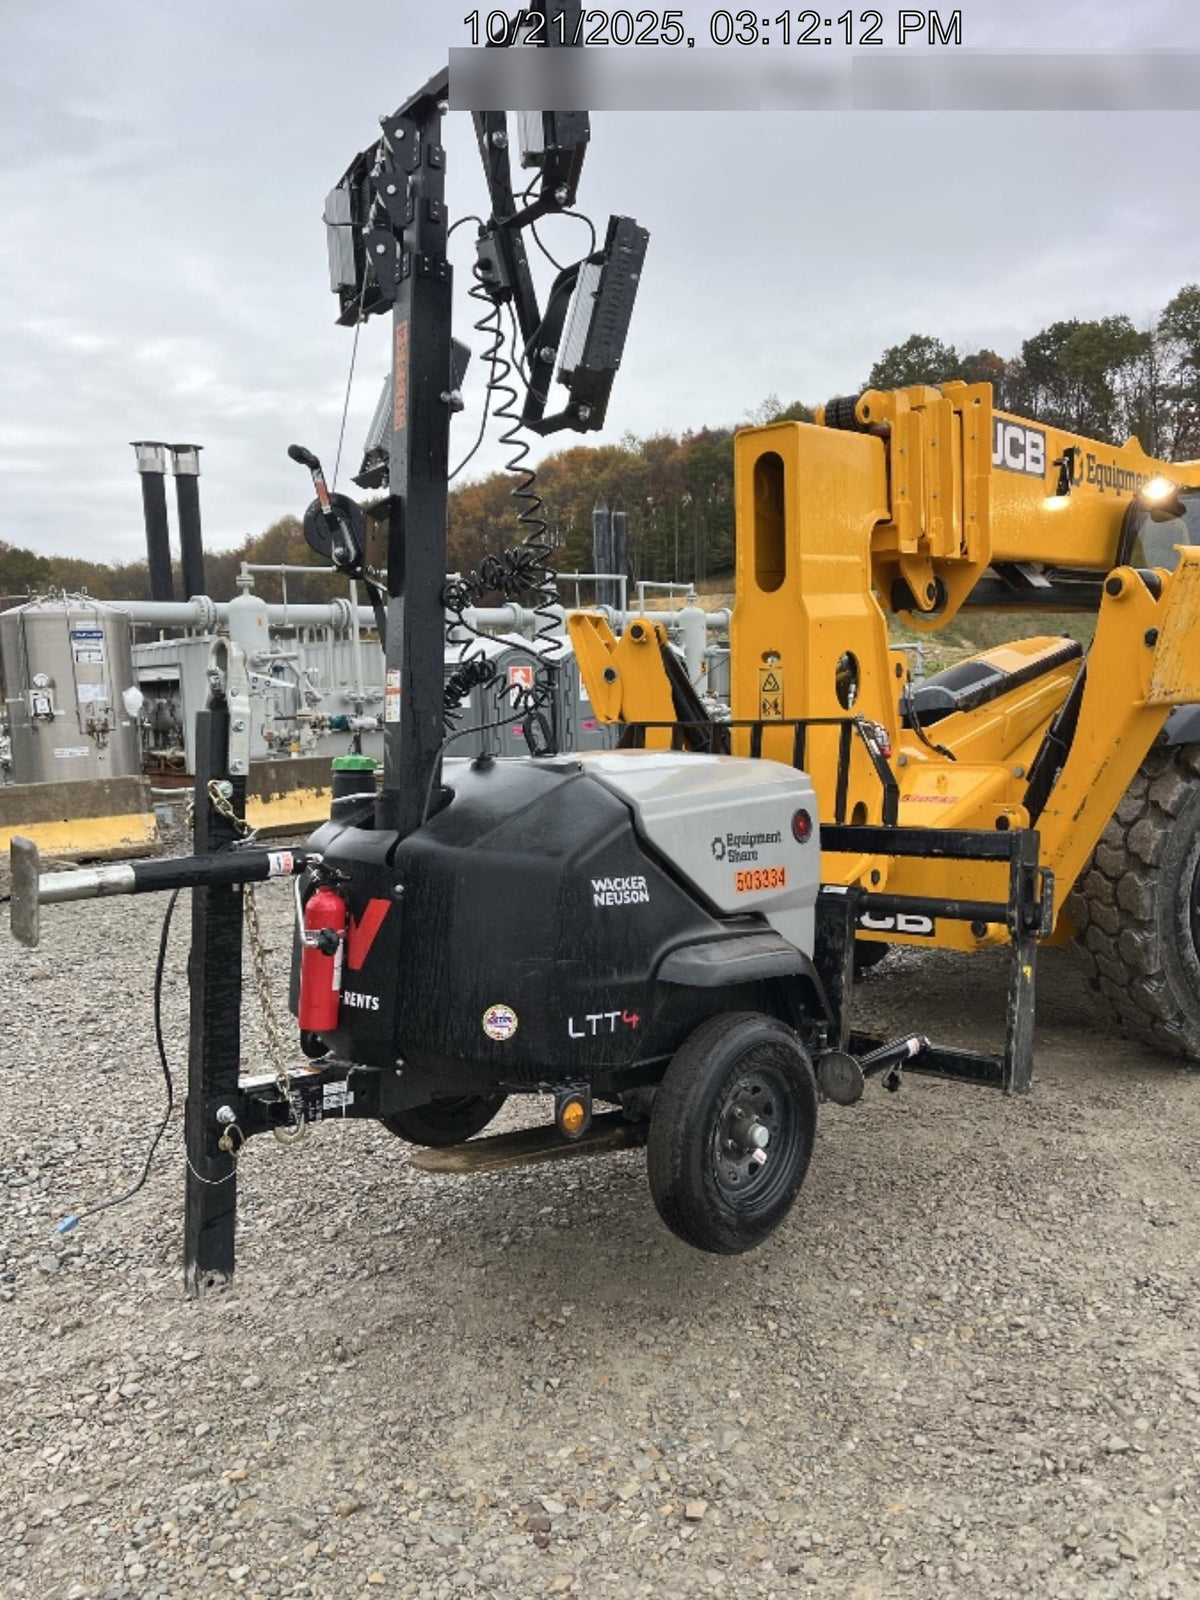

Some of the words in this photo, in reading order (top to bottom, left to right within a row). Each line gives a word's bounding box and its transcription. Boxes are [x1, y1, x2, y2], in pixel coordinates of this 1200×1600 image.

[993, 422, 1044, 474] JCB
[726, 830, 781, 848] Equipment
[727, 849, 758, 863] Share
[591, 875, 647, 892] WACKER
[736, 866, 785, 892] 503334
[593, 889, 650, 908] NEUSON
[568, 1009, 641, 1039] LTT4
